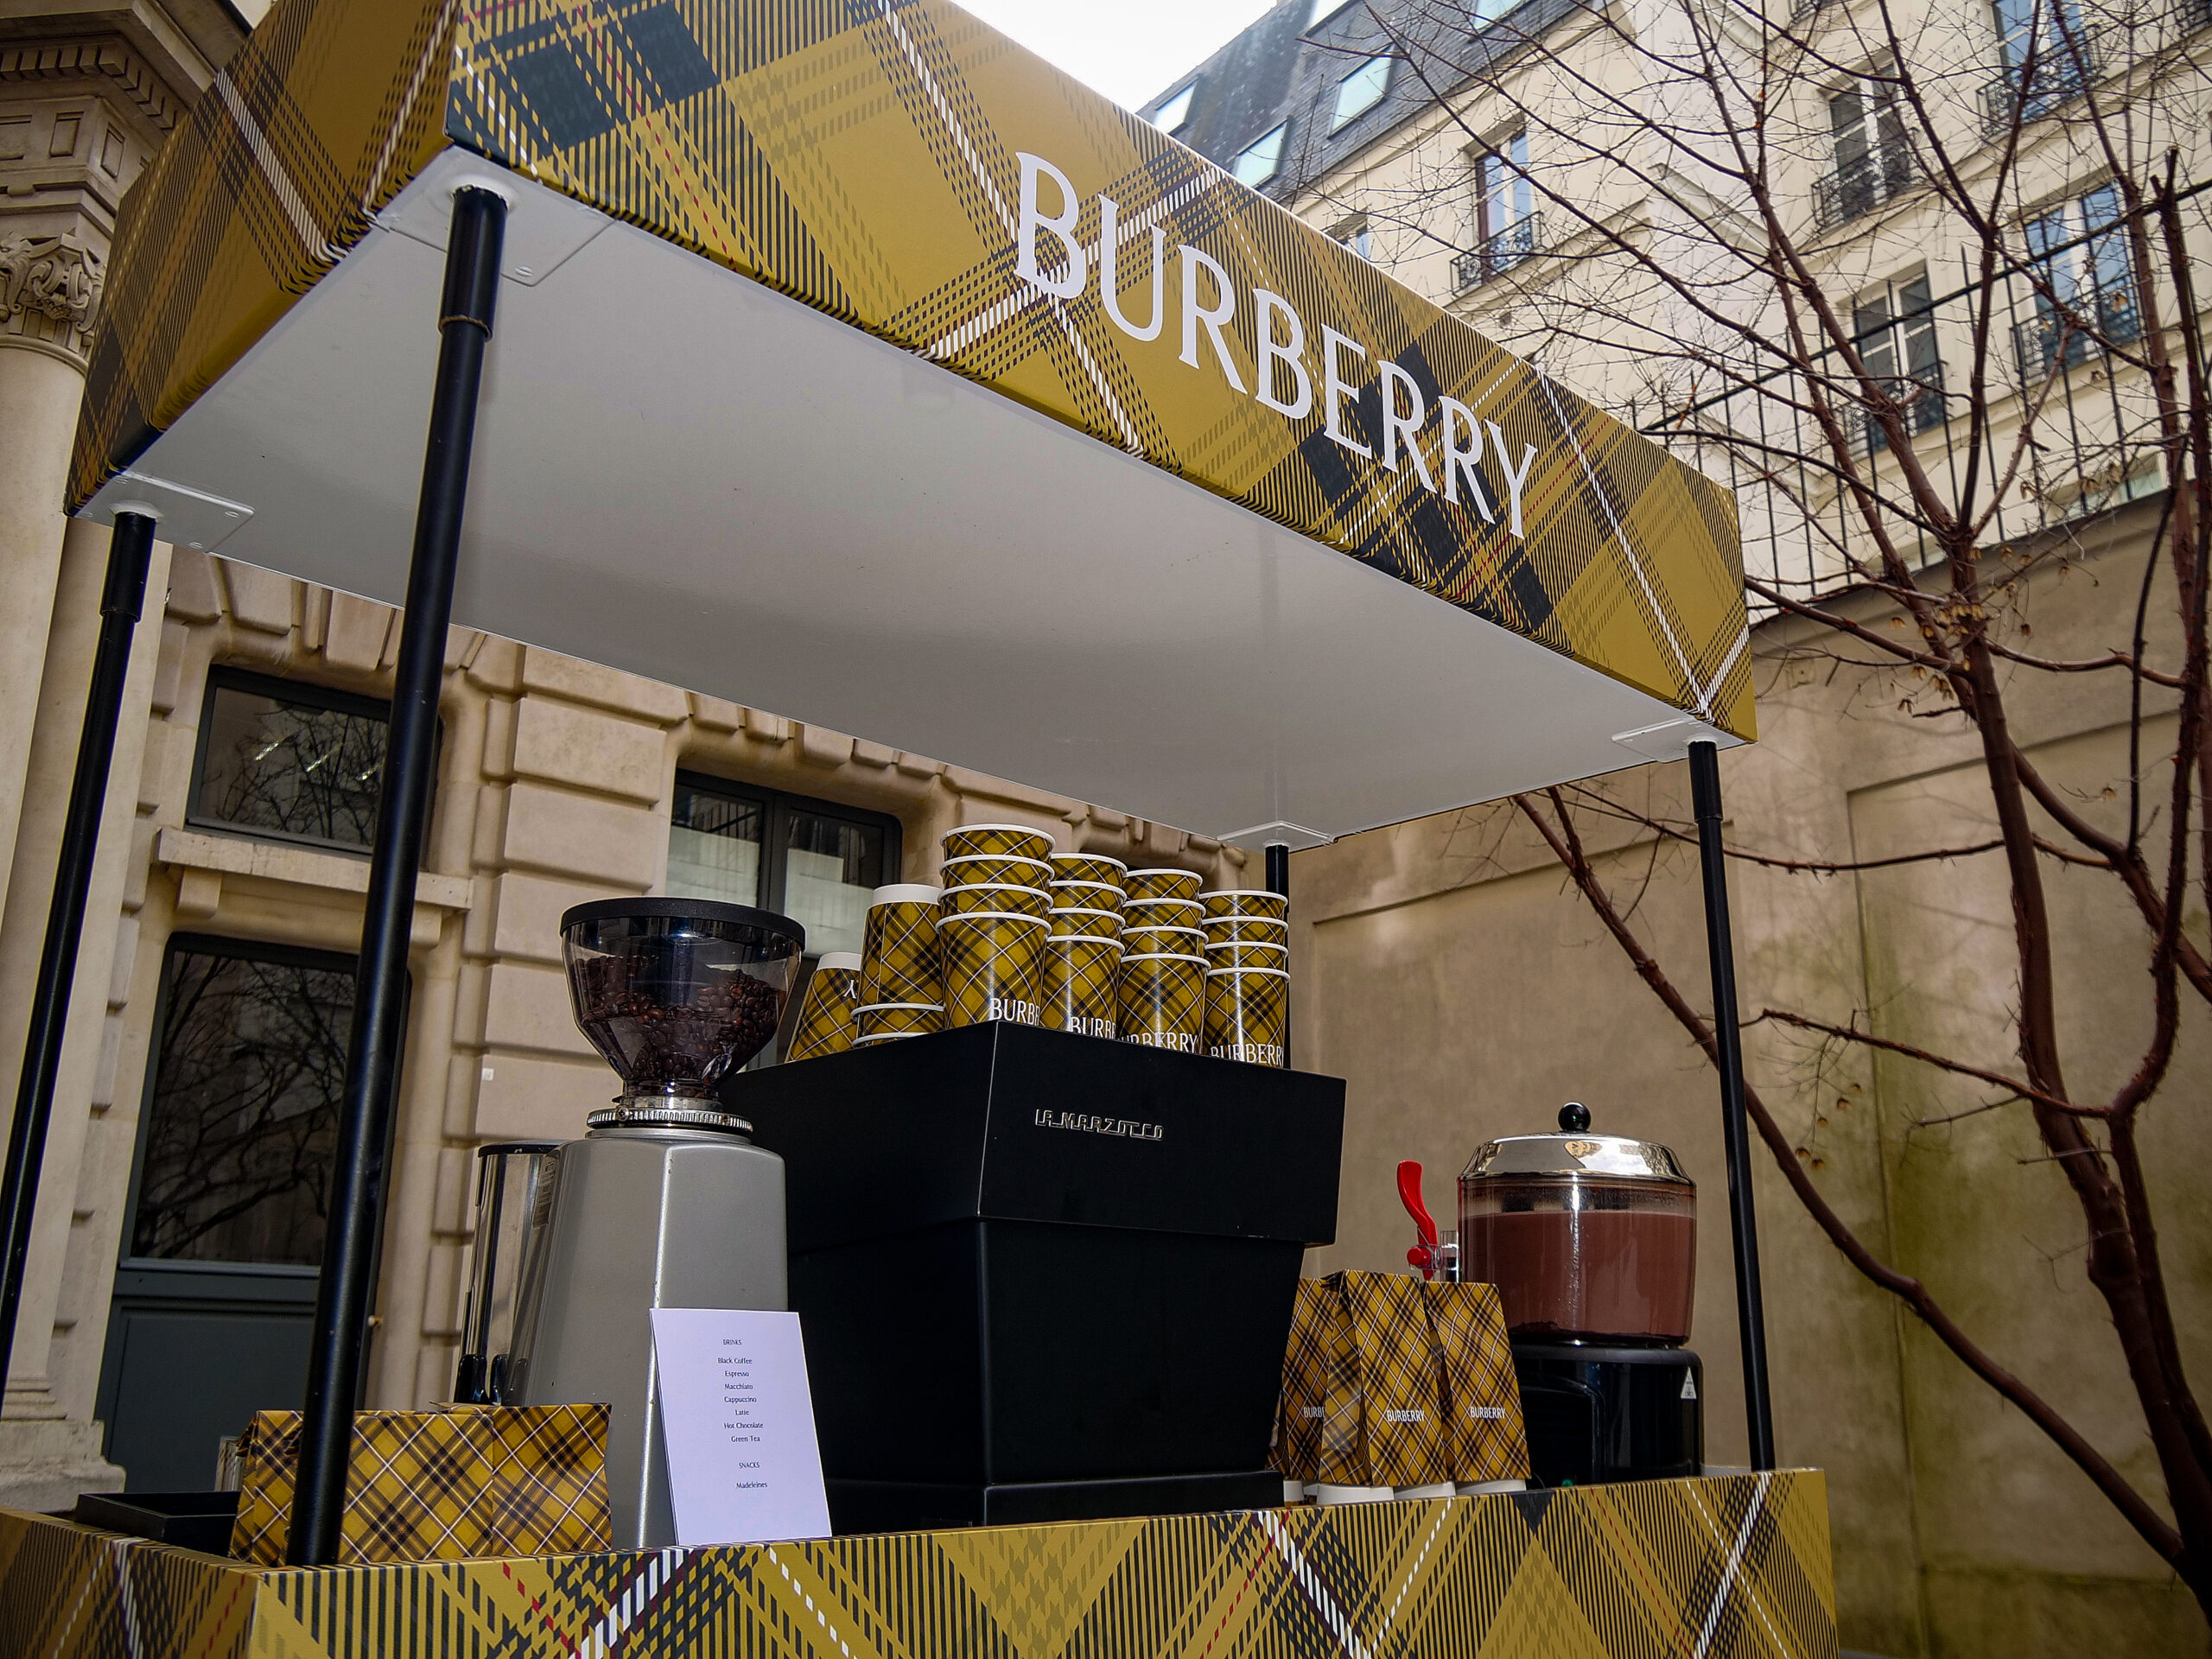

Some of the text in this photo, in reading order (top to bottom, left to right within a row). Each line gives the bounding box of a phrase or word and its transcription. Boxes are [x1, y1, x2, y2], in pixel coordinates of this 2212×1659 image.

[1014, 151, 1538, 540] BURBERRY
[1035, 1109, 1053, 1128] LA
[724, 1370, 749, 1378] Espresso
[1386, 1409, 1426, 1423] BURBERRY
[1470, 1406, 1506, 1420] BURBERRY
